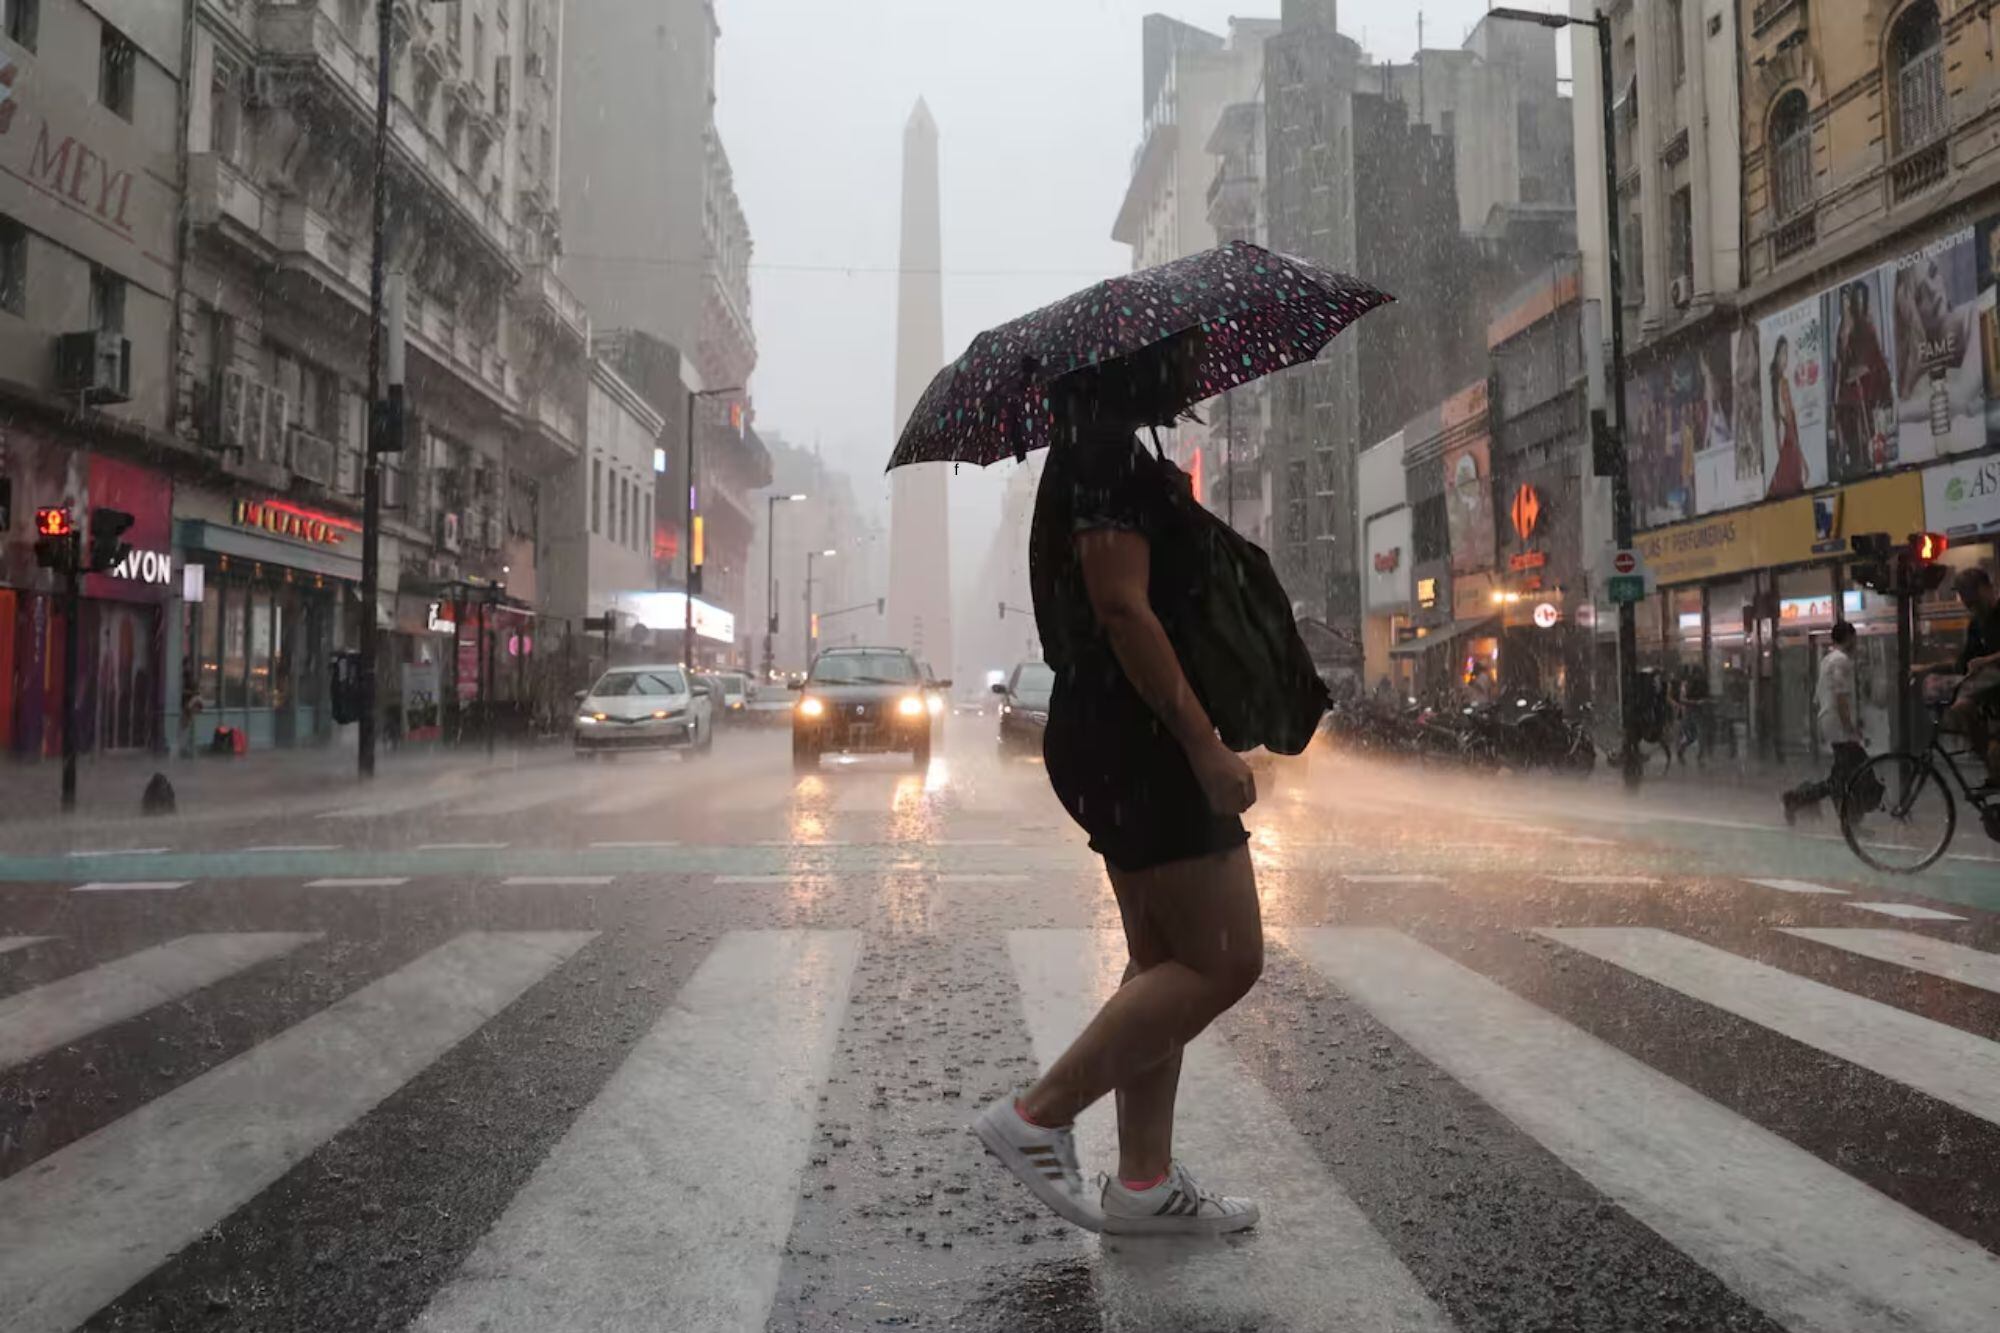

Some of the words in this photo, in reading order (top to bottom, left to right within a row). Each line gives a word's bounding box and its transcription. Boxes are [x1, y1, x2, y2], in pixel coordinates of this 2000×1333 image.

[1918, 334, 1957, 361] FAME
[1969, 461, 2000, 498] AS
[113, 549, 171, 585] AVON
